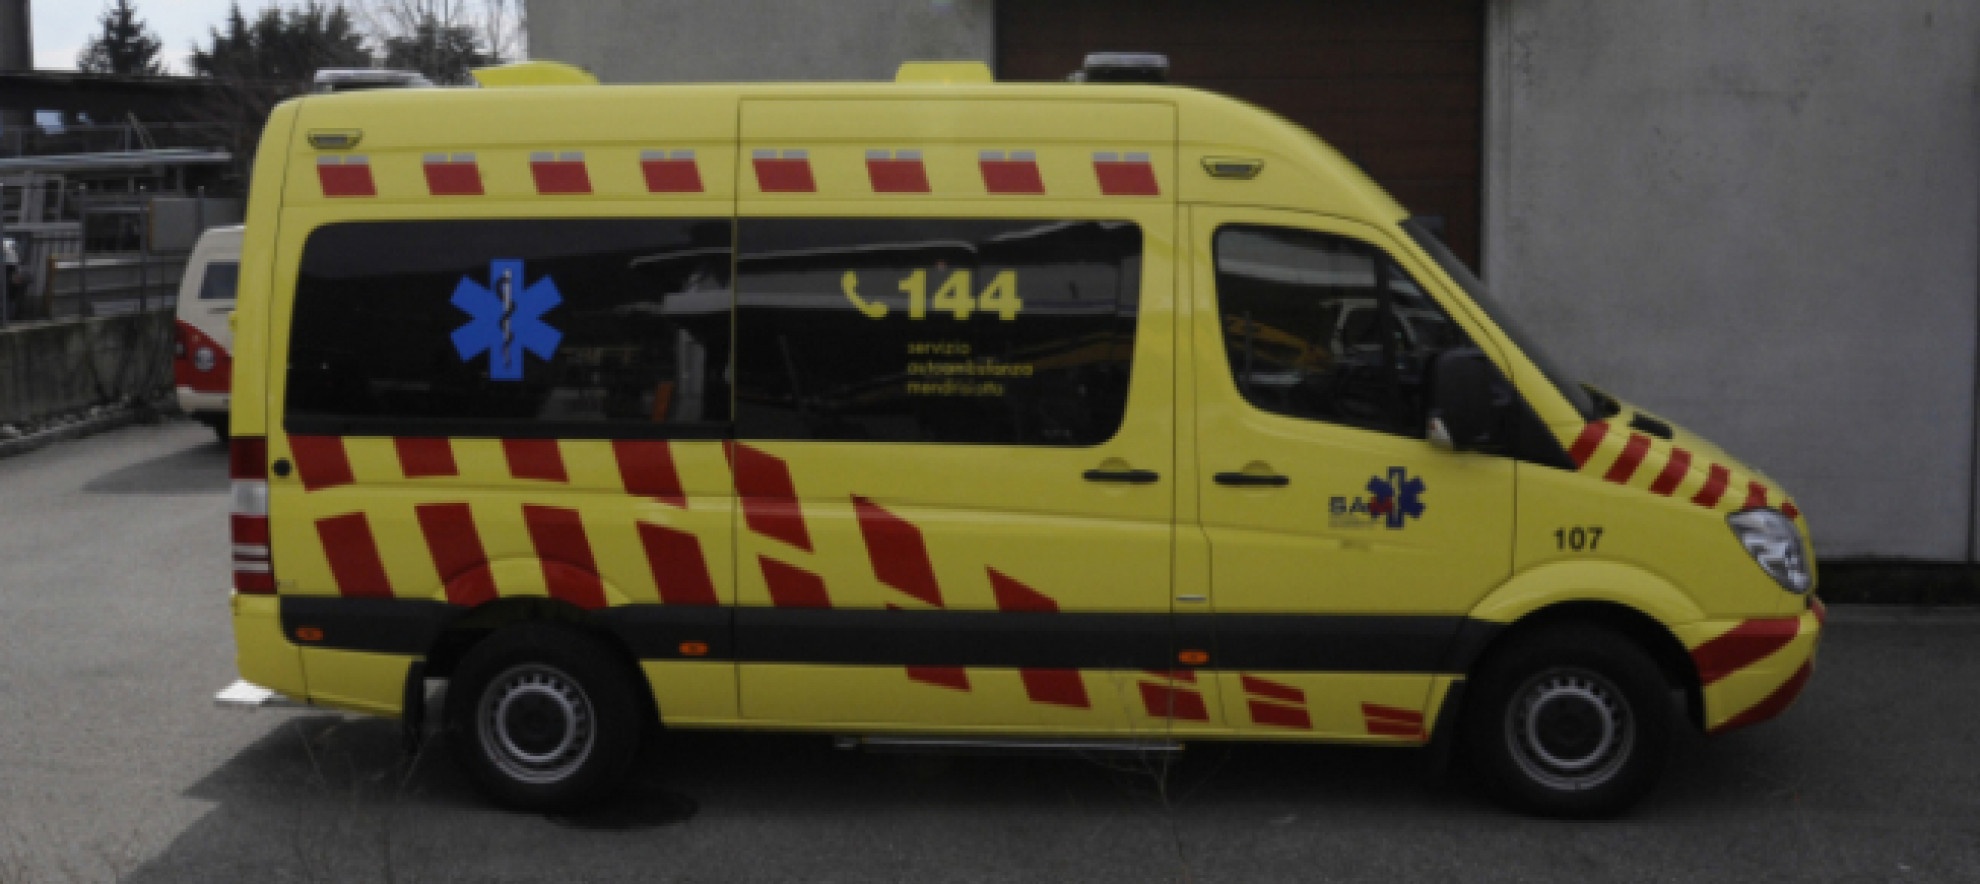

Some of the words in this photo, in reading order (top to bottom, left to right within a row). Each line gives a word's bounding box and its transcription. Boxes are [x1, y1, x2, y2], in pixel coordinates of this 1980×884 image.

[898, 268, 1023, 321] 144
[907, 341, 972, 355] servizio
[1553, 526, 1605, 552] 107
